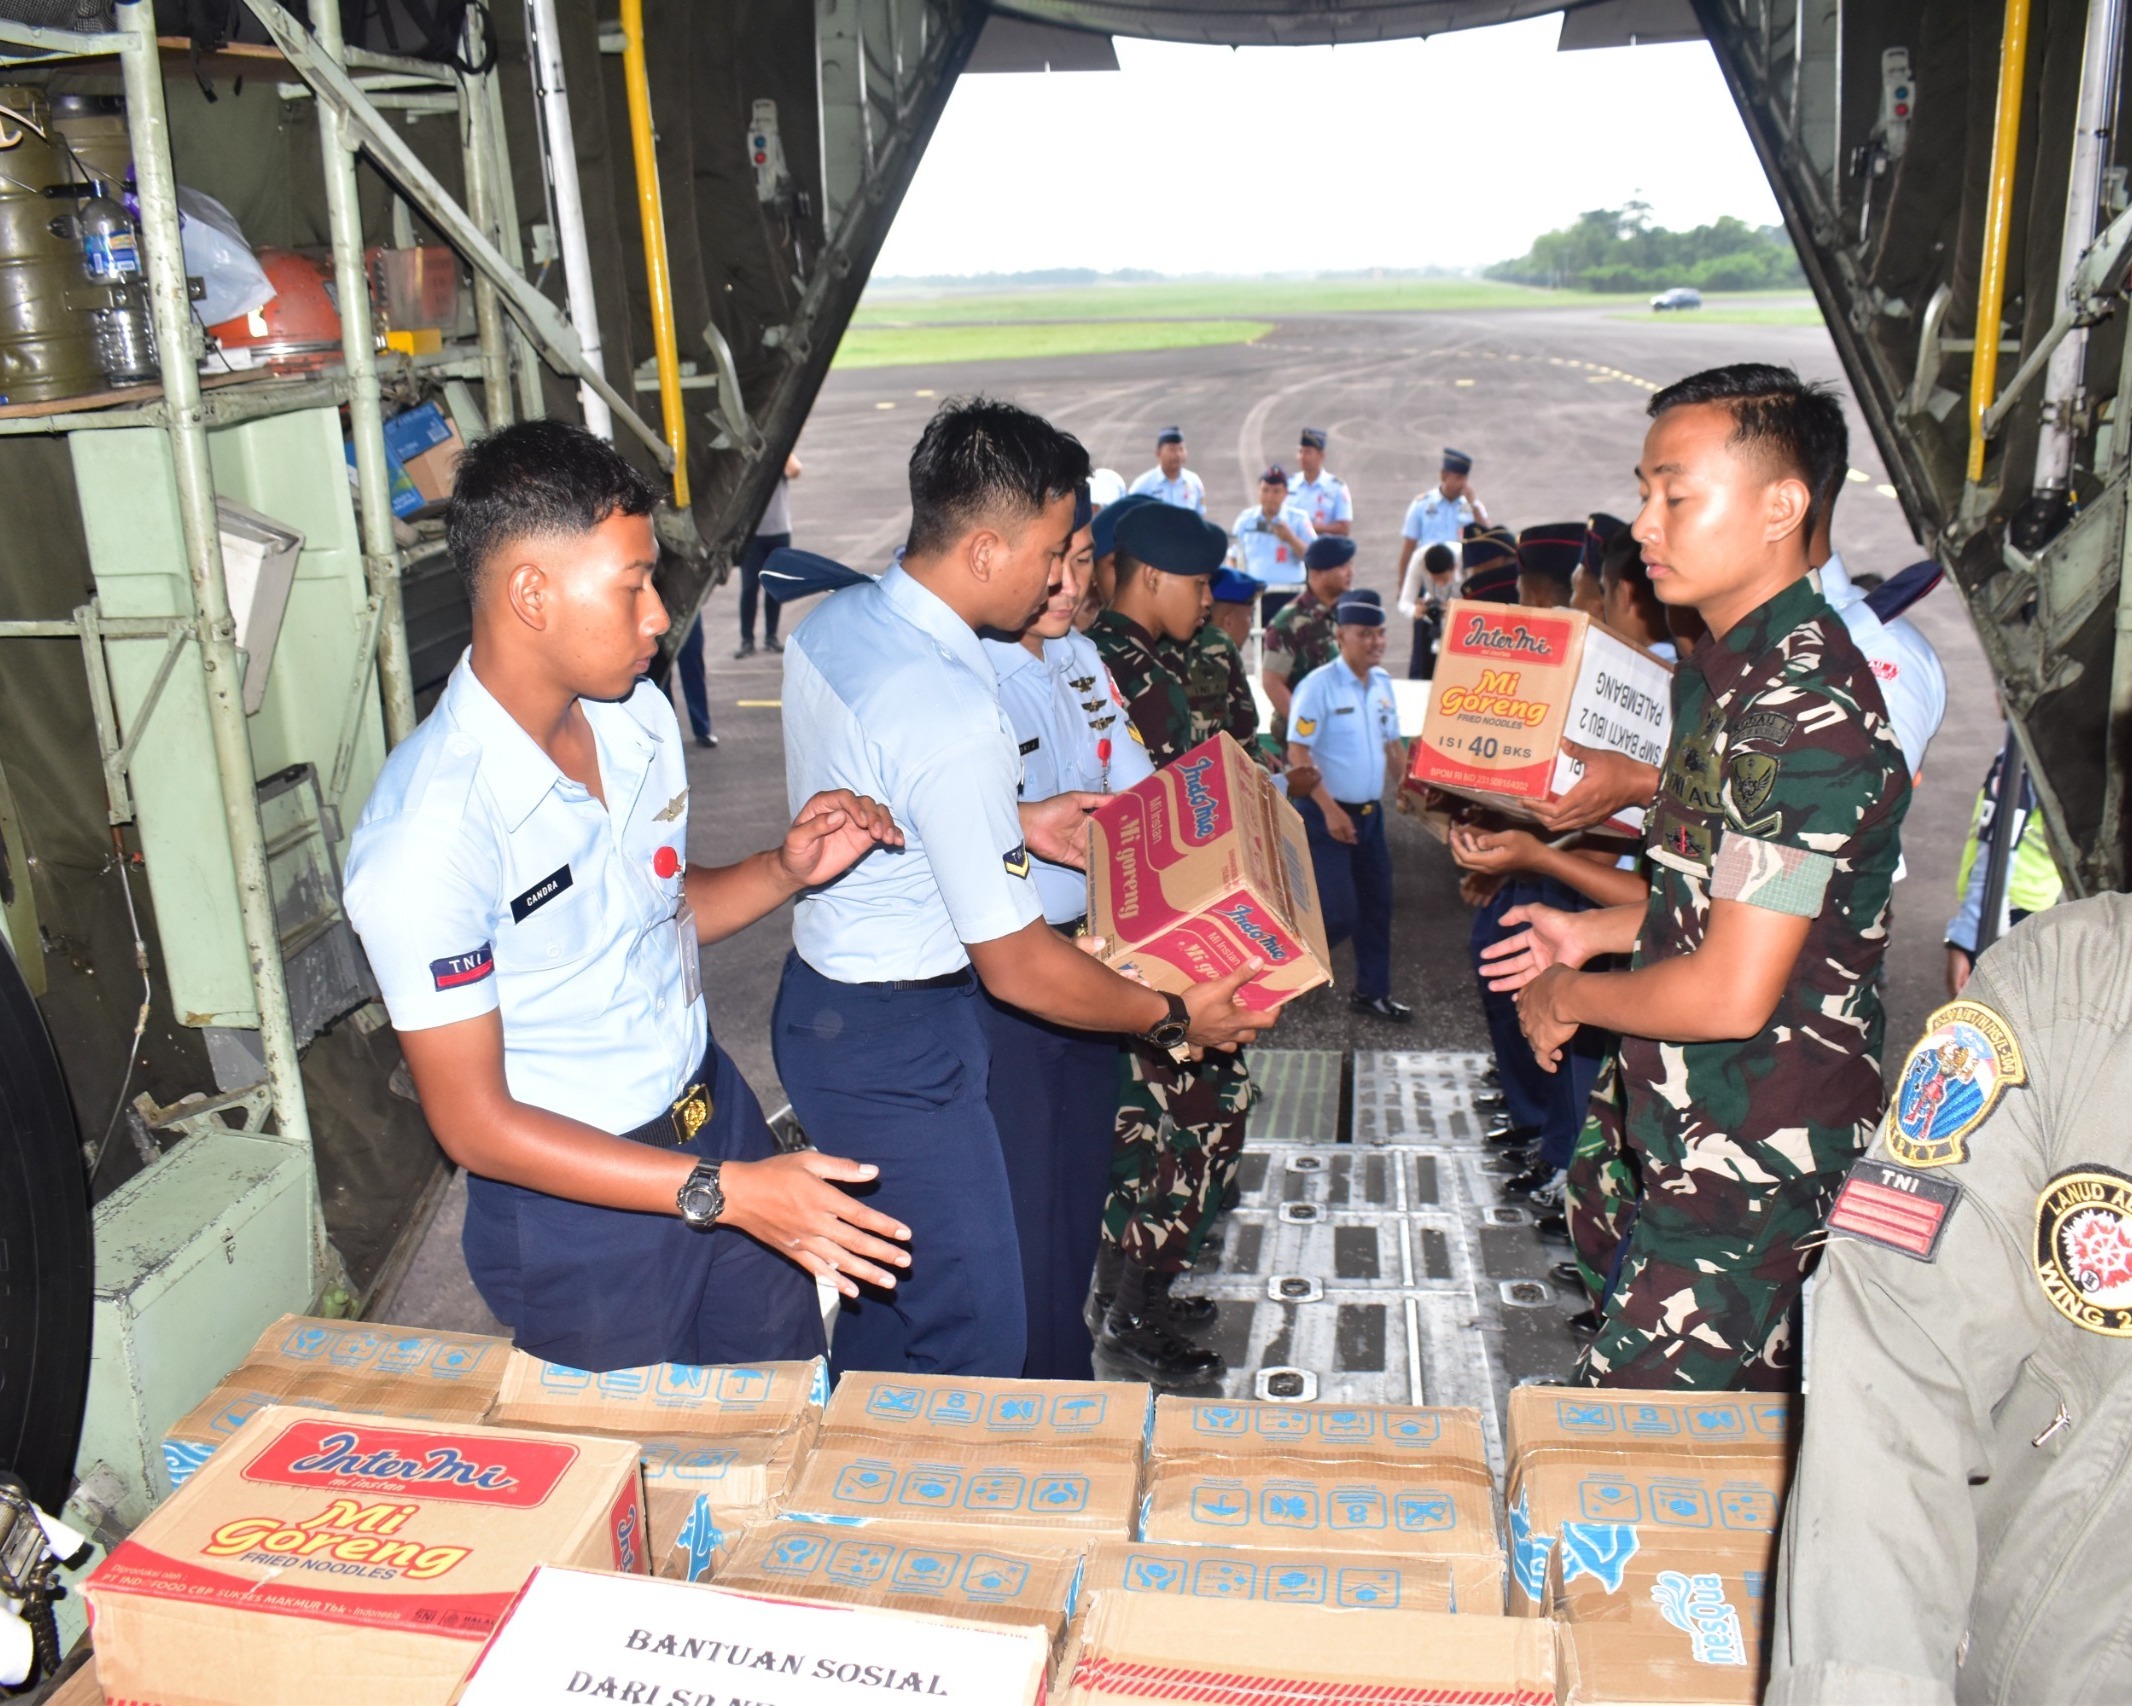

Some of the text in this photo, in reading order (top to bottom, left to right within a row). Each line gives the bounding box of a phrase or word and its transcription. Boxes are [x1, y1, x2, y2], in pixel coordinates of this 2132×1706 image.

[1474, 669, 1521, 695] Mi
[1596, 671, 1665, 727] PALEMBANG
[1439, 684, 1550, 728] Goreng
[1457, 713, 1523, 729] FRIED NOODLES
[1439, 736, 1532, 759] ISI 40 BKS
[1580, 707, 1662, 765] SMP BAKTI IBU 2
[1117, 815, 1140, 920] Mi goreng
[526, 880, 559, 907] CANDRA
[447, 953, 483, 975] TNI
[1882, 1169, 1920, 1194] TNI
[2048, 1183, 2105, 1216] LANUD
[2040, 1260, 2132, 1330] WING 2
[300, 1499, 420, 1534] Mi
[201, 1516, 474, 1580] Goreng
[240, 1551, 398, 1580] FRIED NOODLES
[102, 1573, 116, 1582] PT
[217, 1588, 262, 1604] SUKSES
[264, 1594, 320, 1611] MAKMUR
[323, 1602, 346, 1614] Tbk
[353, 1607, 402, 1620] Indonesia
[624, 1629, 949, 1697] BANTUAN SOSIAL
[565, 1669, 662, 1706] DARI
